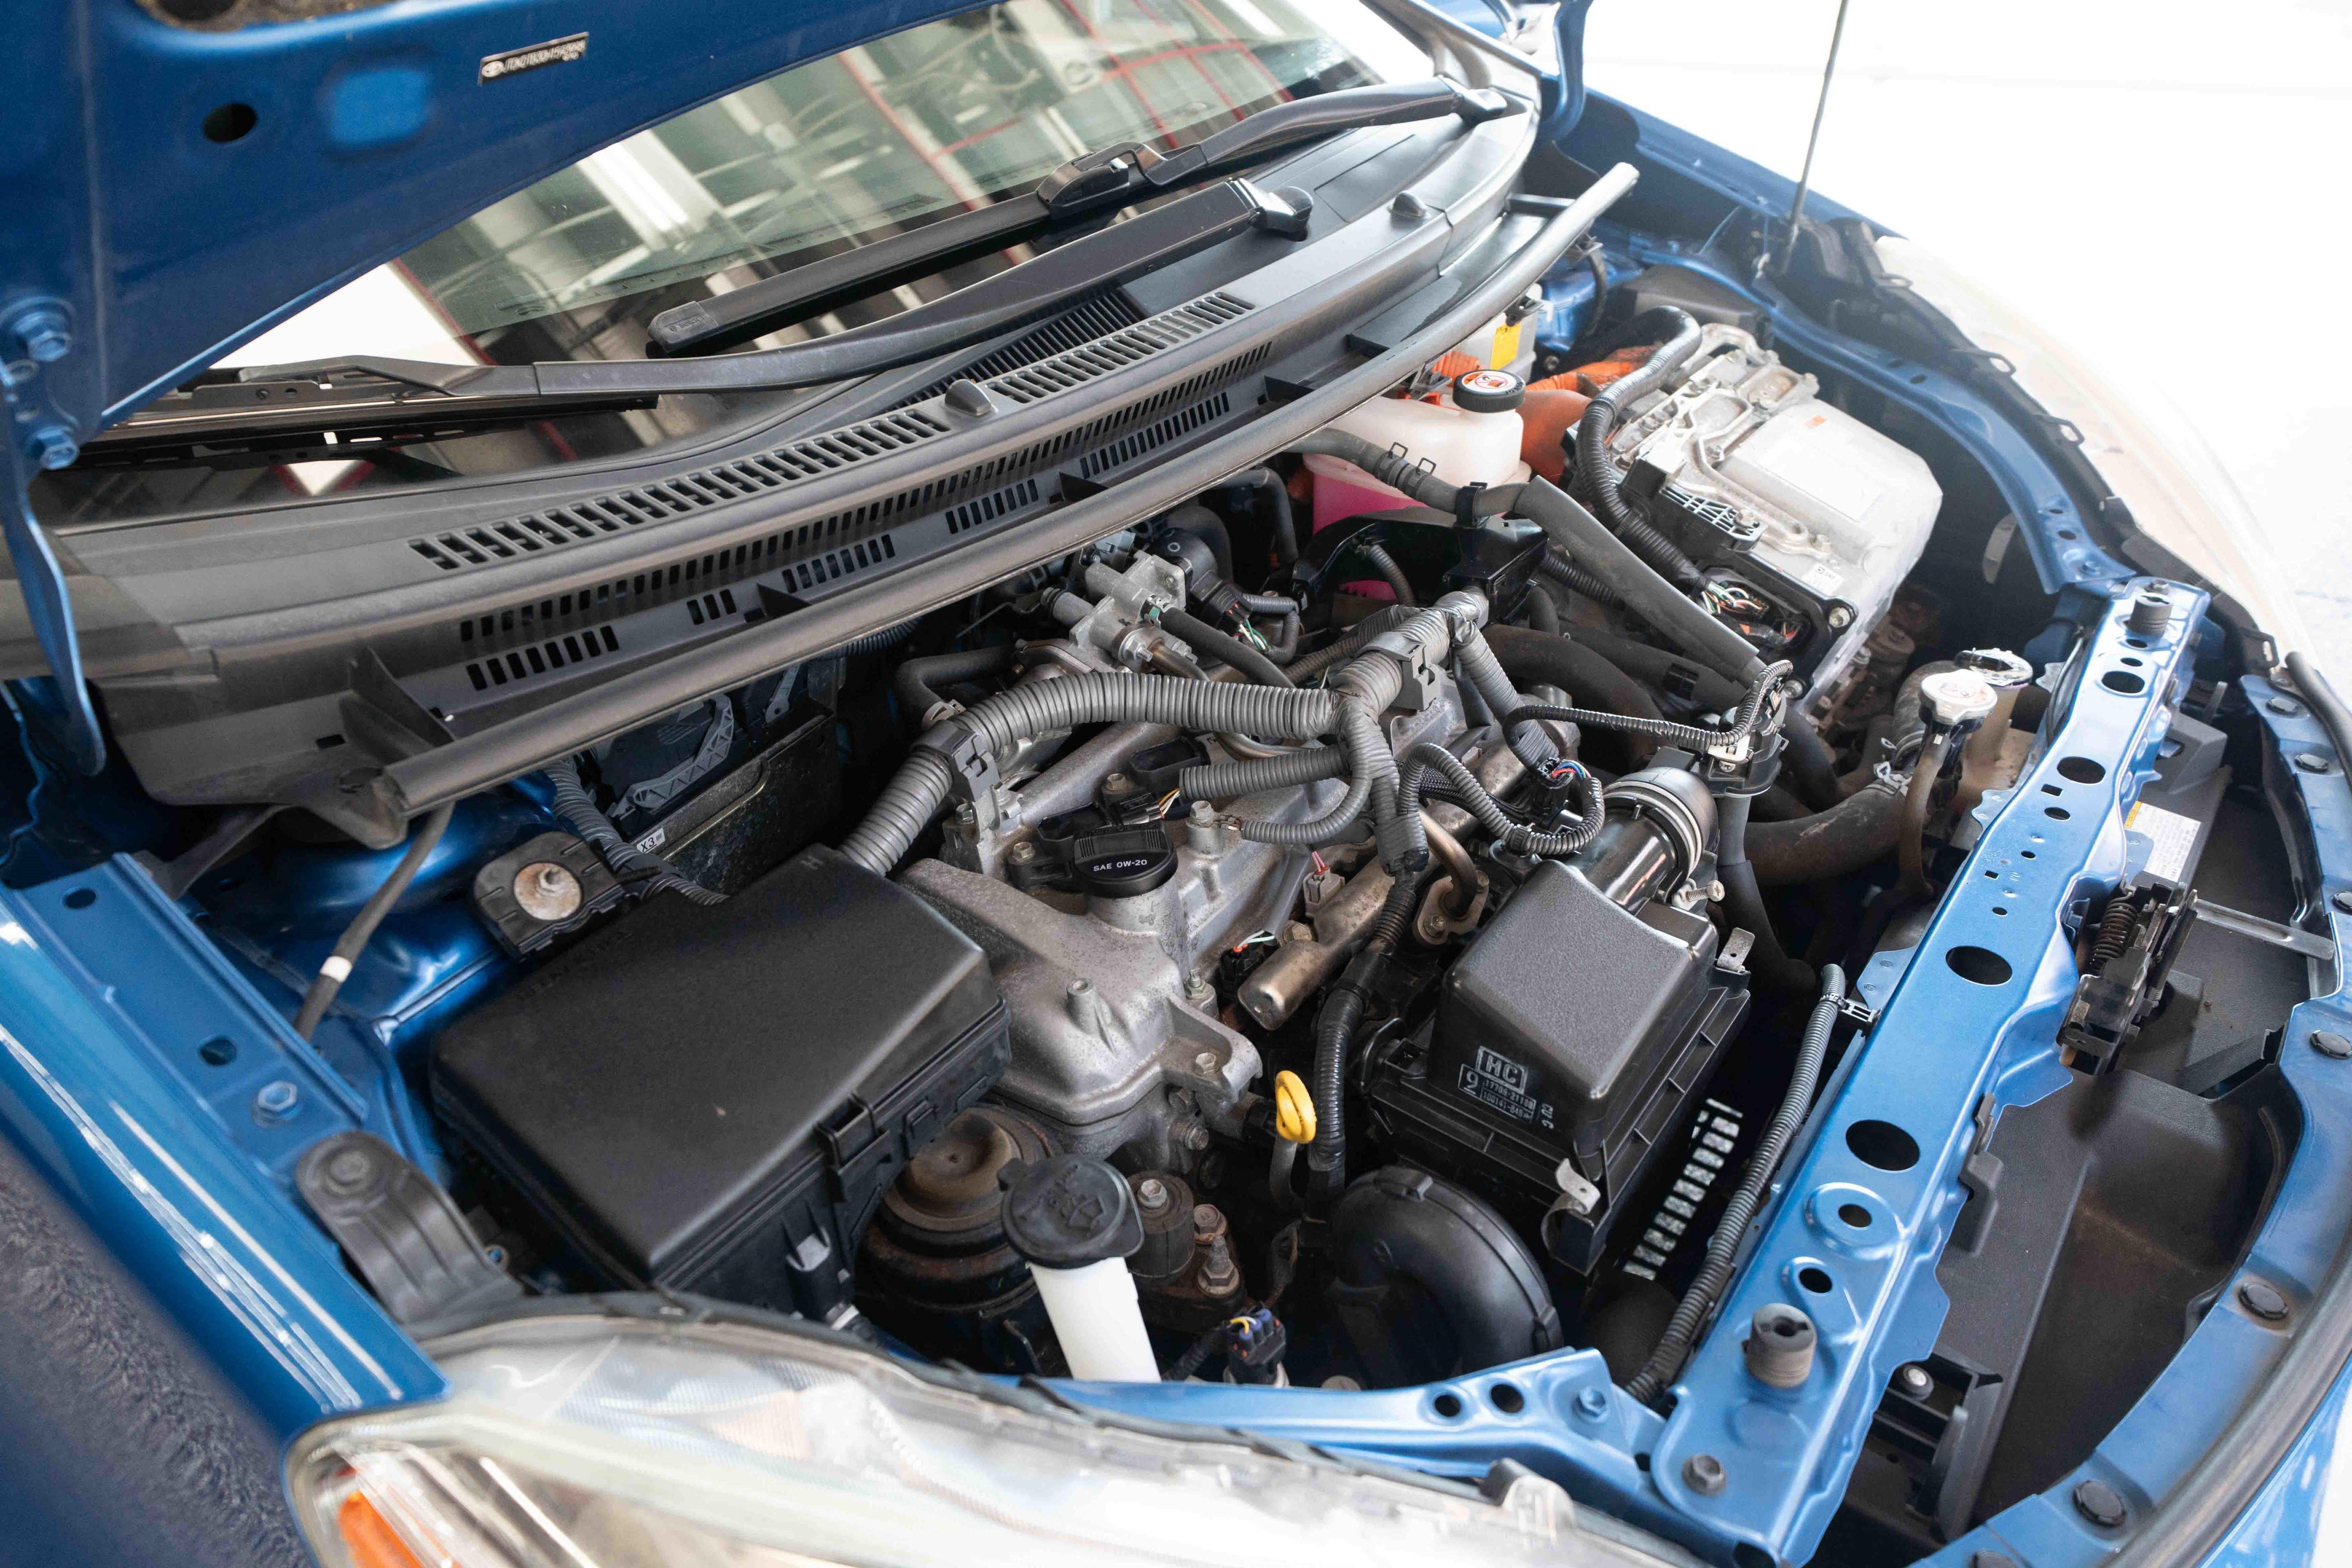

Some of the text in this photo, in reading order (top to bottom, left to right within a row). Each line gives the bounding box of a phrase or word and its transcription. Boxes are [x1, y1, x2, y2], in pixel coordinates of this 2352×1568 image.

[641, 837, 655, 853] X3
[1093, 859, 1147, 871] SAE 0W-20
[1486, 1054, 1518, 1084] HC
[1466, 1071, 1479, 1089] 9
